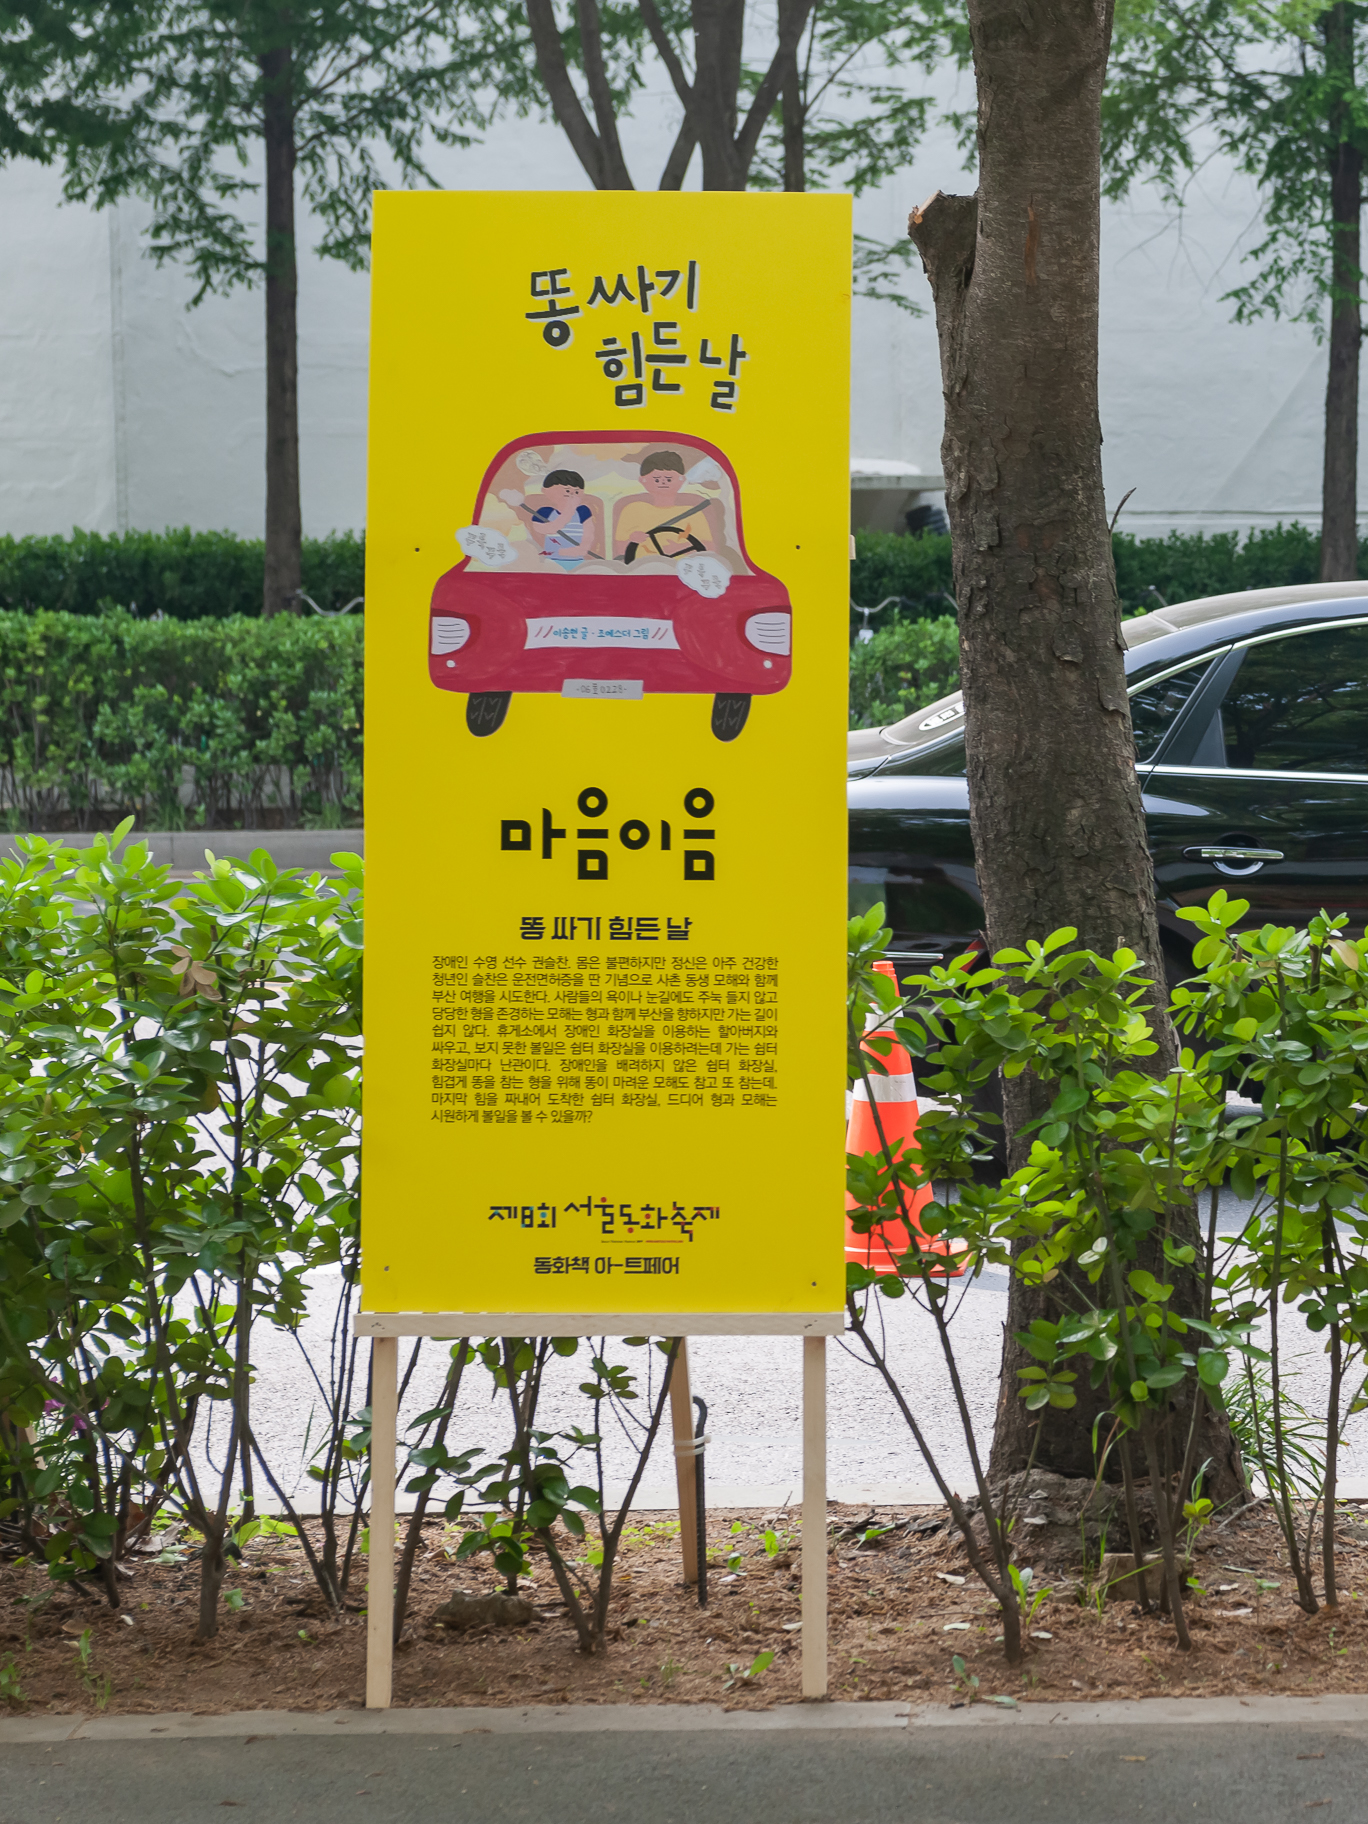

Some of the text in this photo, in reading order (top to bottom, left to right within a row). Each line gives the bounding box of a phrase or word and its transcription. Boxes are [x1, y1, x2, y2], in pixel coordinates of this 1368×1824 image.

[526, 261, 697, 347] 똥 싸기
[596, 321, 747, 411] 힘든 날
[552, 627, 650, 640] 이송현 글 조에스더 그림
[501, 786, 716, 881] 마음이음
[519, 915, 693, 941] 똥 싸기 힘든 날
[432, 956, 468, 969] 장애인
[473, 956, 497, 969] 수영
[502, 956, 527, 969] 선수
[576, 956, 601, 969] 몸은
[605, 957, 666, 969] 불편하지만
[671, 957, 707, 970] 정신은
[713, 957, 737, 970] 아주
[742, 957, 779, 970] 건강한
[432, 973, 778, 987] 청년인 슬찬은 운전면허증을 딴 기념으로 사촌 동생 모해와 함께
[432, 990, 778, 1004] 부산 여행을 시도한다. 사람들의 욕이나 눈길에도 주눅 들지 않고
[432, 1007, 778, 1021] 당당한 형을 존경하는 모해는 형과 함께 부산을 향하지만 가는 길이
[432, 1024, 778, 1038] 쉽지 않다. 휴게소에서 장애인 화장실을 이용하는 할아버지와
[431, 1041, 777, 1055] 싸우고, 보지 못한 볼일은 쉼터 화장실을 이용하려는데 가는 쉼터
[431, 1058, 492, 1072] 화장실마다
[500, 1059, 551, 1072] 난관이다.
[560, 1059, 608, 1072] 장애인을
[617, 1059, 664, 1072] 배려하지
[673, 1059, 697, 1072] 않은
[706, 1060, 729, 1072] 쉼터
[432, 1075, 467, 1089] 힘겹게
[471, 1075, 496, 1089] 똥을
[500, 1075, 524, 1089] 참는
[528, 1076, 552, 1089] 형을
[556, 1076, 580, 1089] 위해
[584, 1076, 608, 1089] 똥이
[613, 1076, 649, 1089] 마려운
[653, 1077, 689, 1089] 모해도
[694, 1076, 718, 1089] 참고
[722, 1077, 734, 1088] 또
[432, 1093, 467, 1105] 마지막
[475, 1093, 498, 1106] 힘을
[505, 1093, 540, 1106] 짜내어
[547, 1093, 584, 1106] 도착한
[591, 1093, 614, 1106] 쉼터
[667, 1094, 703, 1106] 드디어
[711, 1093, 735, 1107] 형과
[741, 1094, 778, 1106] 모해는
[431, 1110, 593, 1123] 시원하게 볼일을 볼 수 있을까?
[488, 1196, 720, 1242] 제8회 서울동화축제
[533, 1256, 680, 1275] 동화책 아트페어
